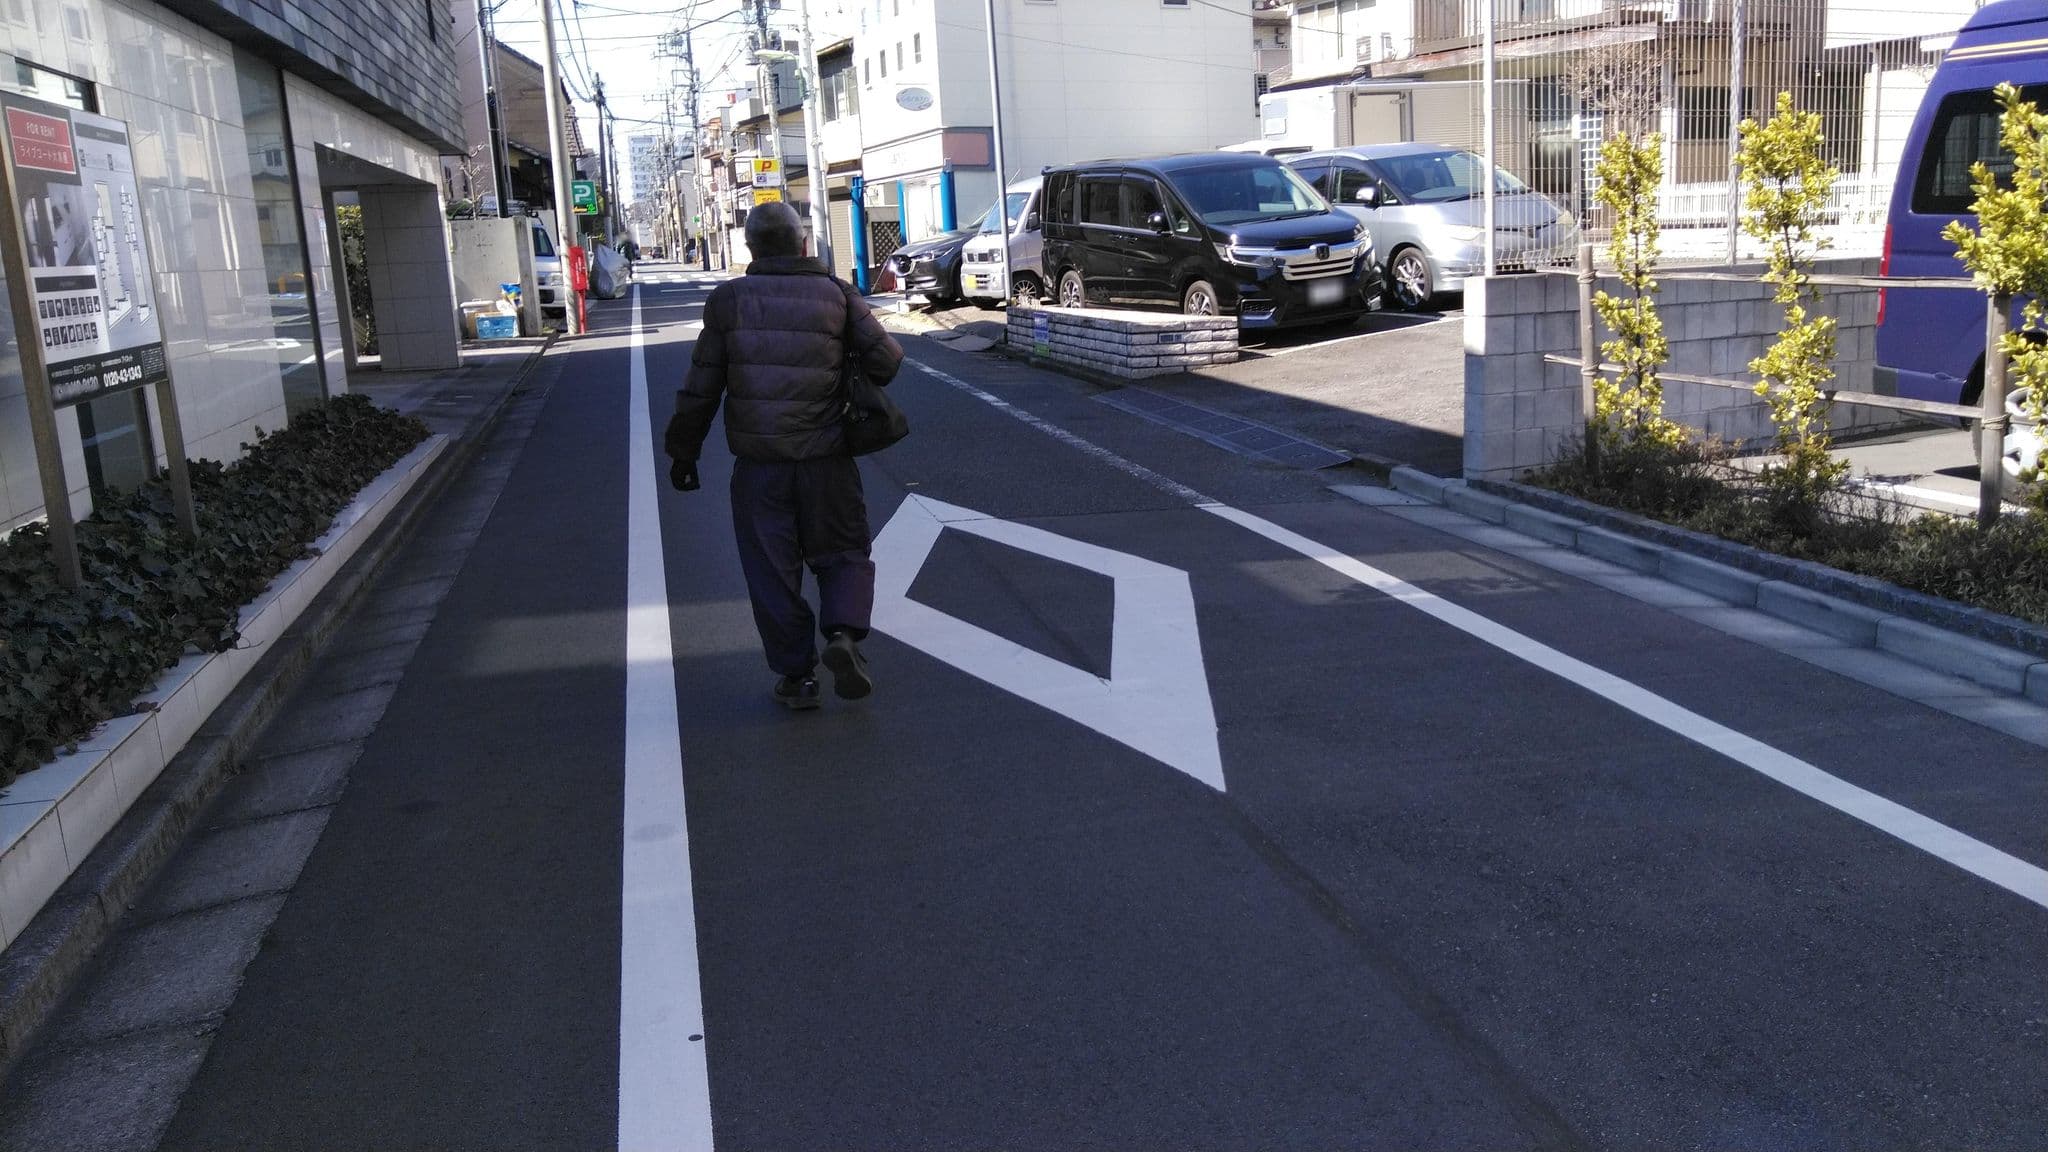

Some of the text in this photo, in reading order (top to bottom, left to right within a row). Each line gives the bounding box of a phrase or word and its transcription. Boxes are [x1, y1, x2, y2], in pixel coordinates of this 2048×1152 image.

[26, 122, 55, 137] FOR RENT
[761, 160, 772, 173] P
[574, 184, 591, 203] P
[103, 365, 142, 388] 0120-43-1343
